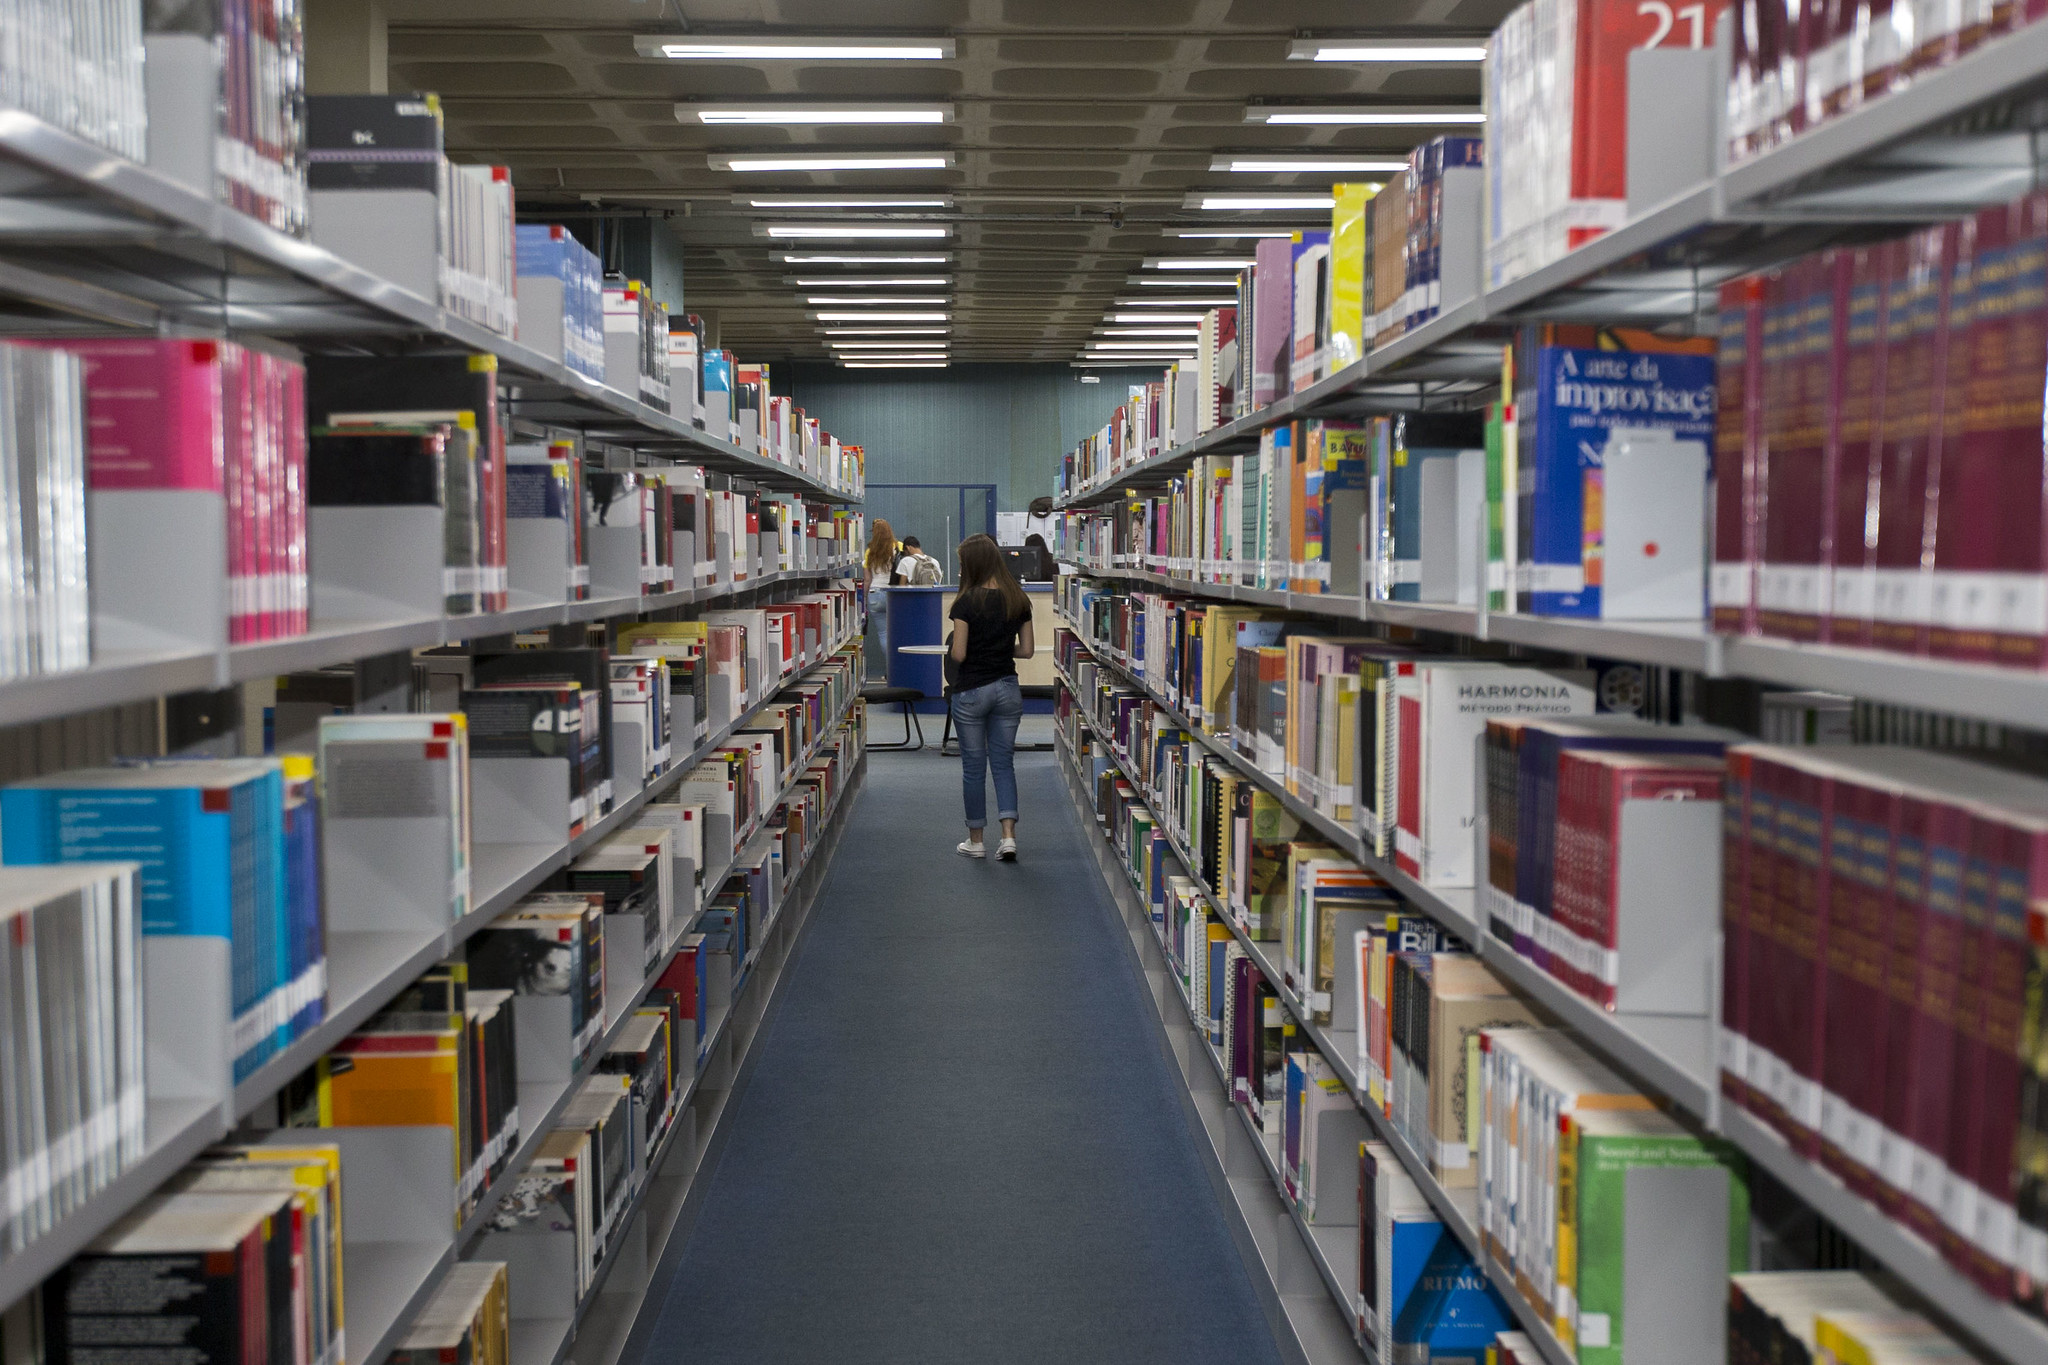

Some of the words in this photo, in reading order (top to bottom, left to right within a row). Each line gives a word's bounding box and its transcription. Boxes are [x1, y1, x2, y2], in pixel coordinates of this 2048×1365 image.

[1585, 359, 1628, 380] arte
[1631, 356, 1659, 382] da
[1460, 686, 1571, 699] HARMONIA
[1402, 921, 1423, 933] The
[1401, 932, 1437, 953] Bill
[1423, 1275, 1487, 1291] RITMO
